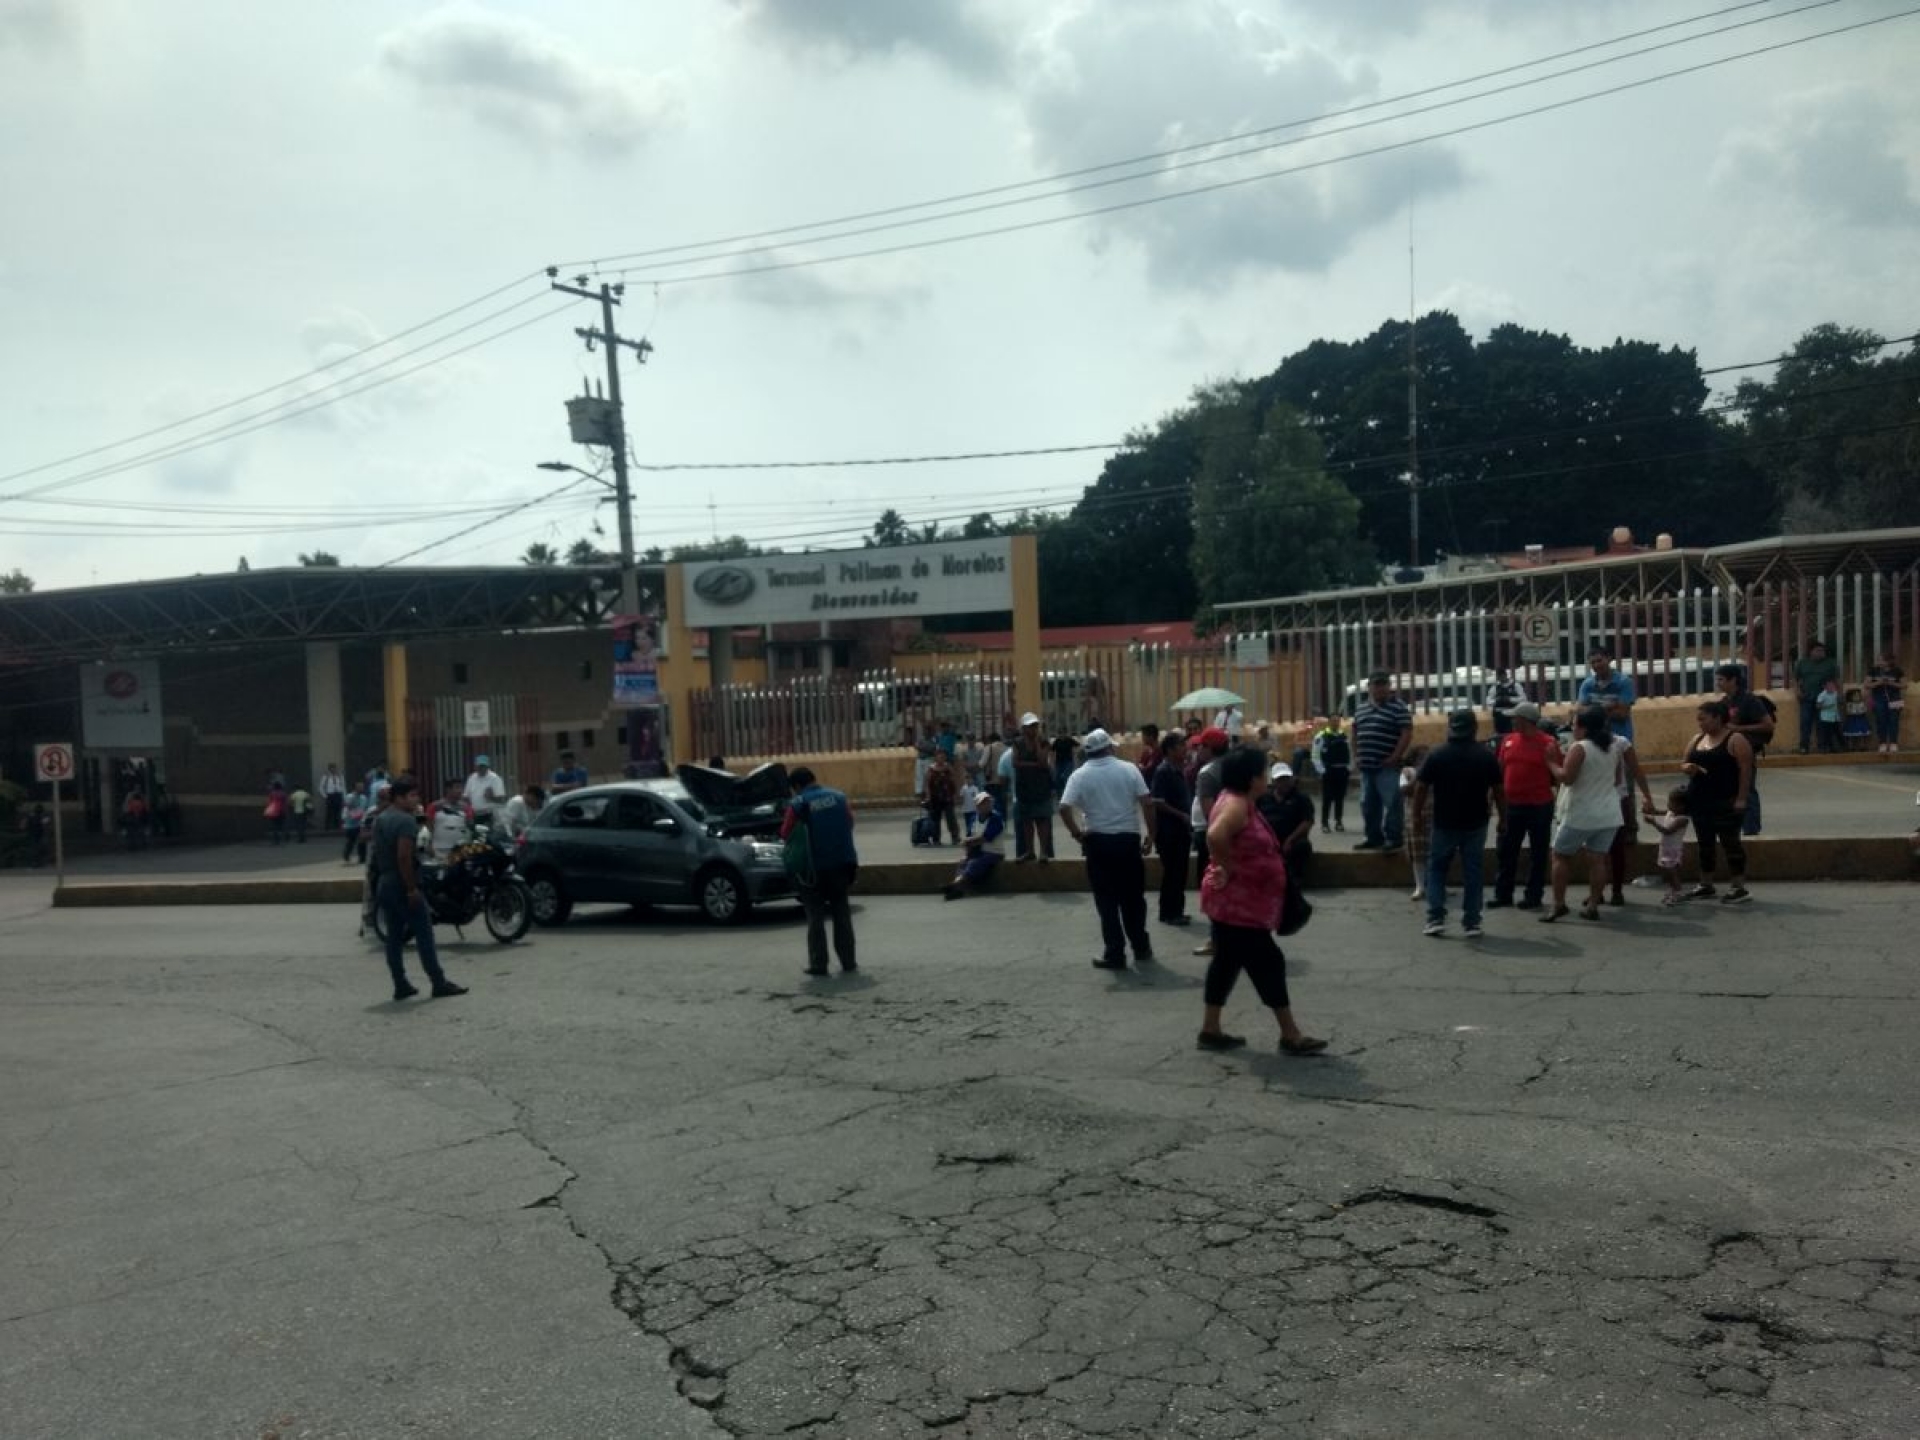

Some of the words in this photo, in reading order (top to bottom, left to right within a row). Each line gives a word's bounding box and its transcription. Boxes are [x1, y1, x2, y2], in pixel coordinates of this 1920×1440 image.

[911, 556, 930, 578] de
[942, 552, 1005, 576] Morelos
[1532, 620, 1547, 638] E
